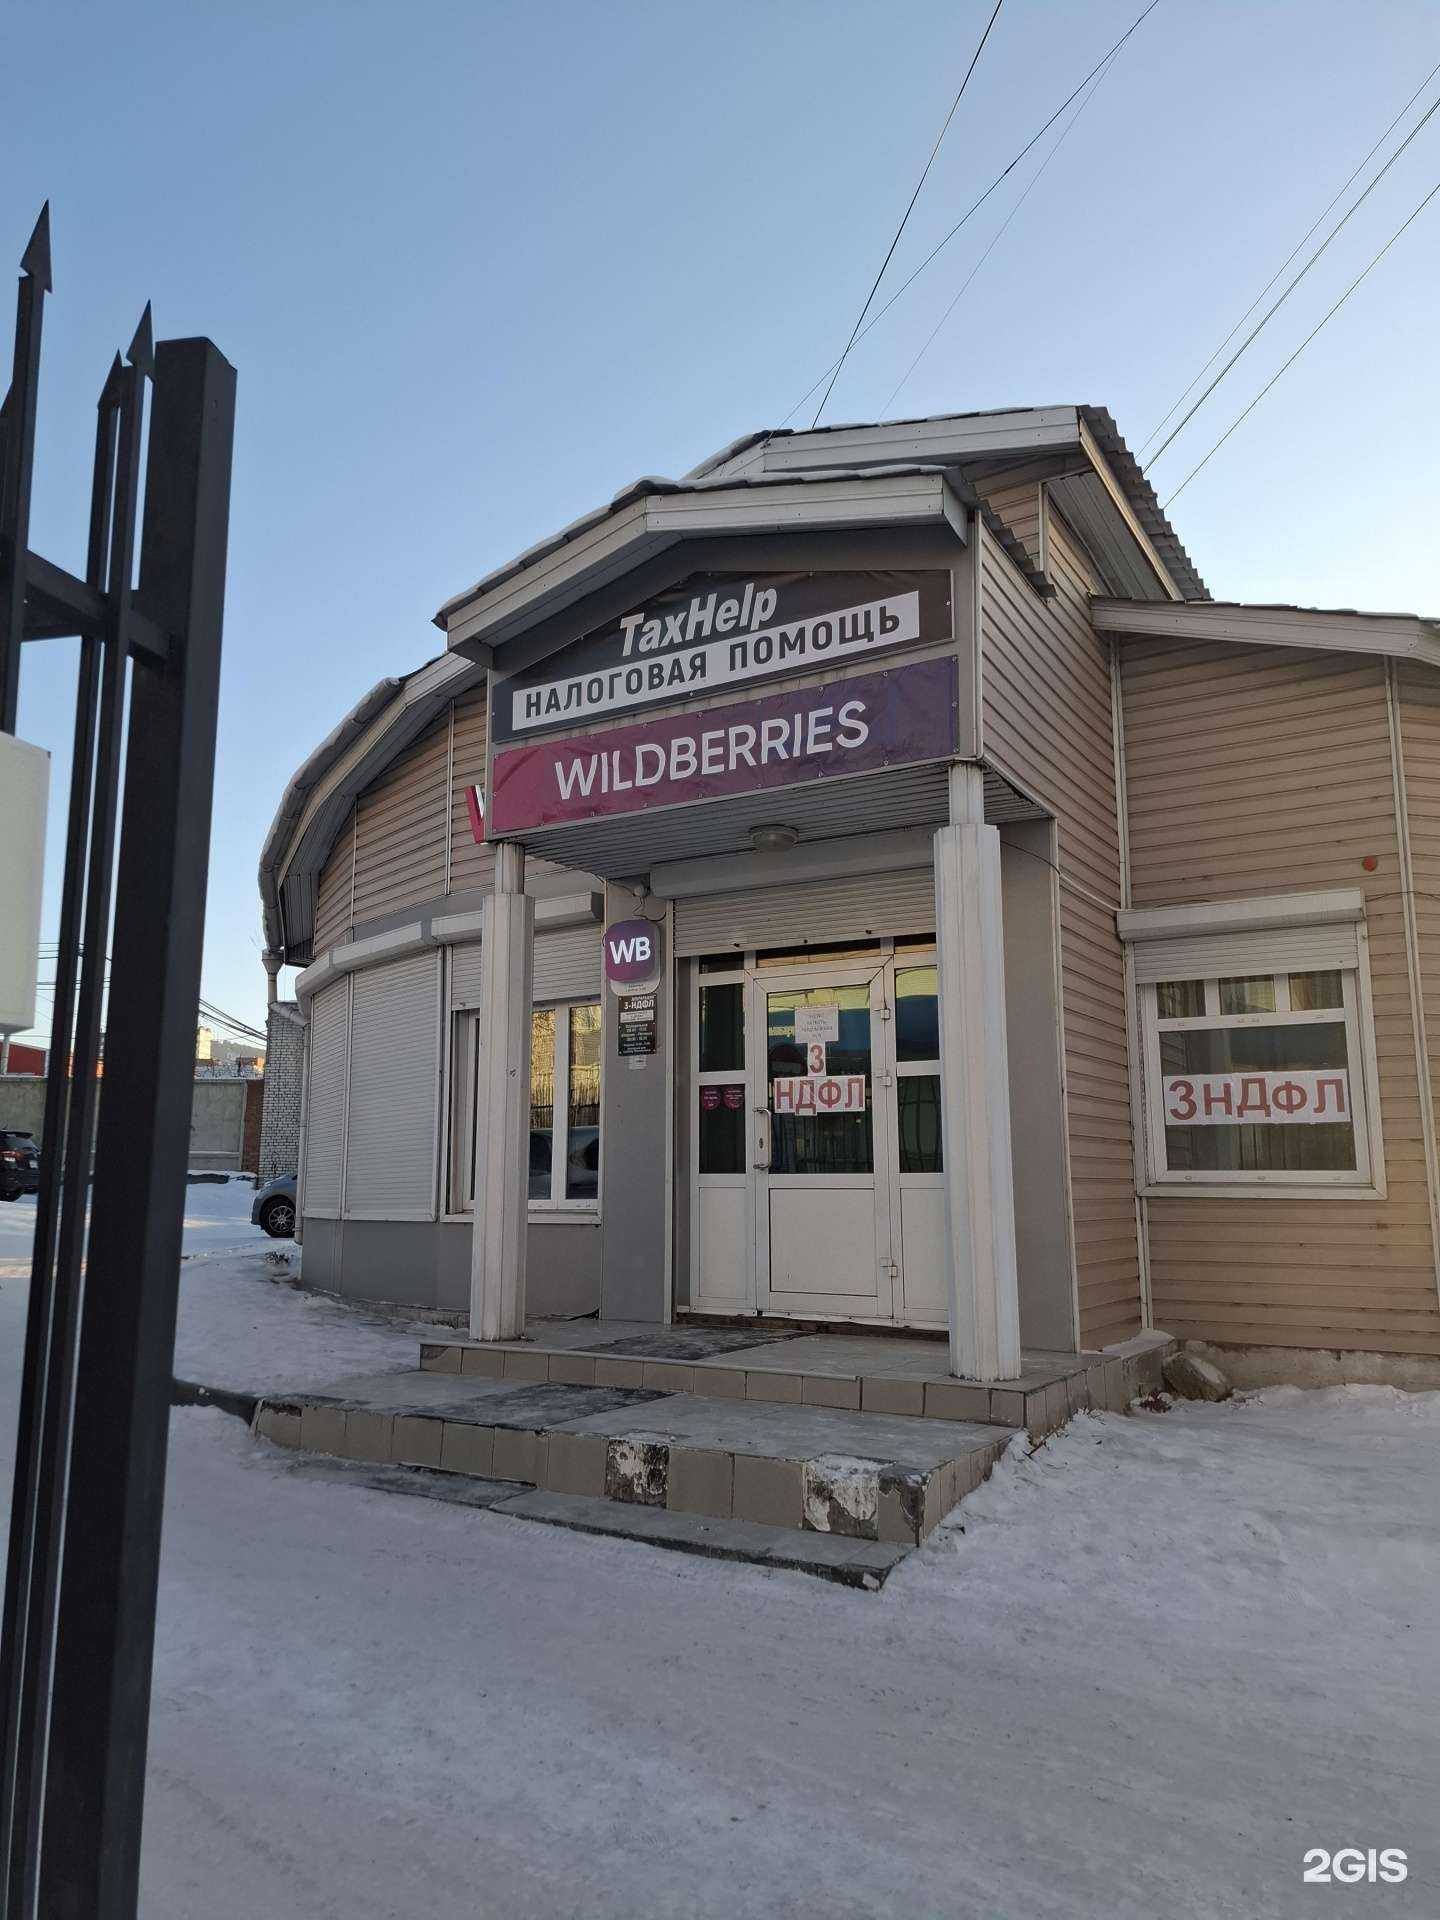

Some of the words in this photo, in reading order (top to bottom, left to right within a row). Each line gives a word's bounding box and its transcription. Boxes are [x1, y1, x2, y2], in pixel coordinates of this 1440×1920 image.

[619, 582, 778, 657] TaxHelp
[525, 650, 707, 719] НАЛОГОВАЯ
[729, 604, 900, 672] ПОМОЩЬ
[554, 700, 869, 800] WILDBERRIES
[609, 936, 651, 965] WB
[776, 1078, 864, 1115] НДФЛ
